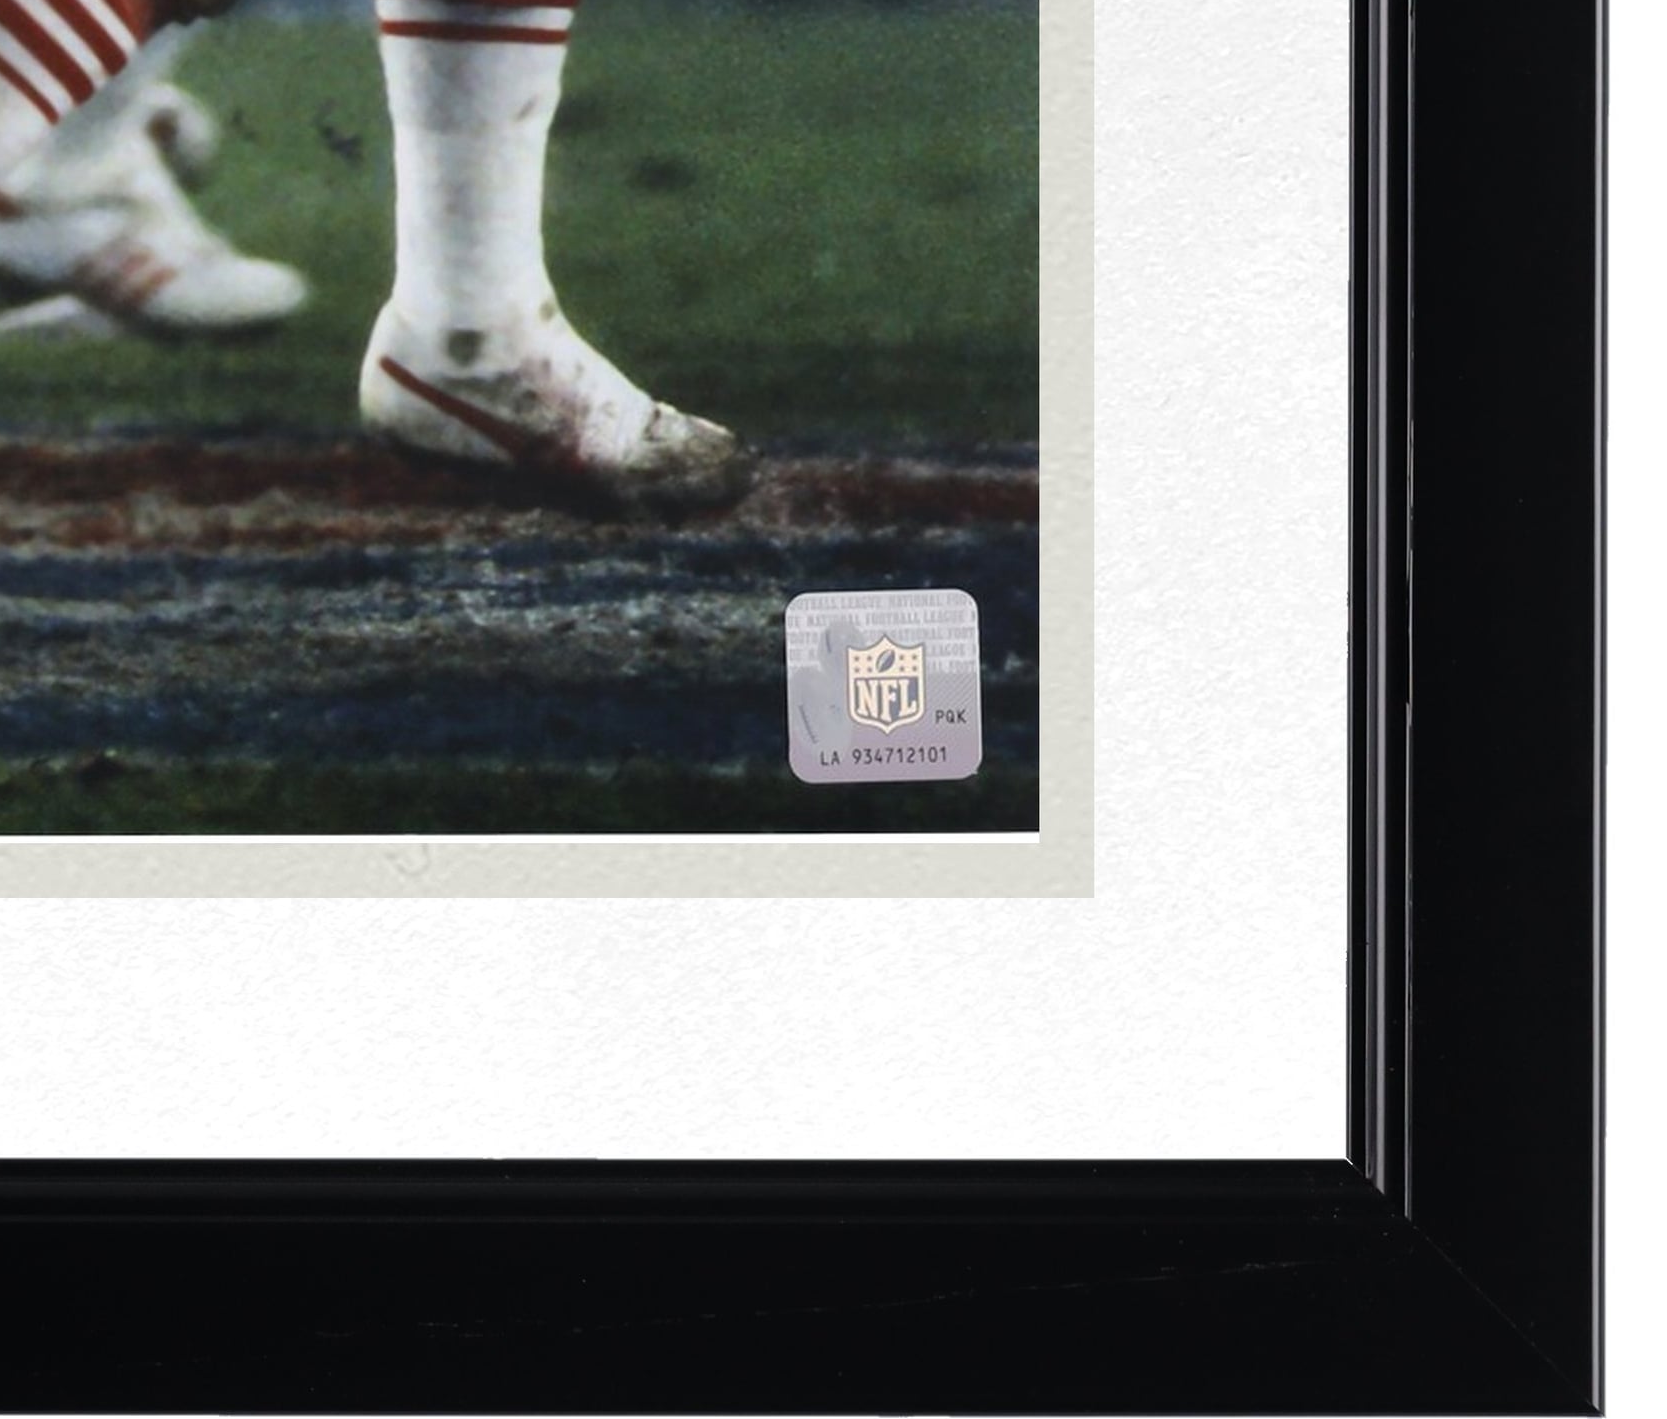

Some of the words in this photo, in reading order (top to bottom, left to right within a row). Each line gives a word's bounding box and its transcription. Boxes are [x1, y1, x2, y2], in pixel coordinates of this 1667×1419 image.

[855, 679, 918, 722] NFL
[934, 709, 967, 725] PQK
[819, 750, 841, 766] LA
[852, 746, 948, 764] 934712101
